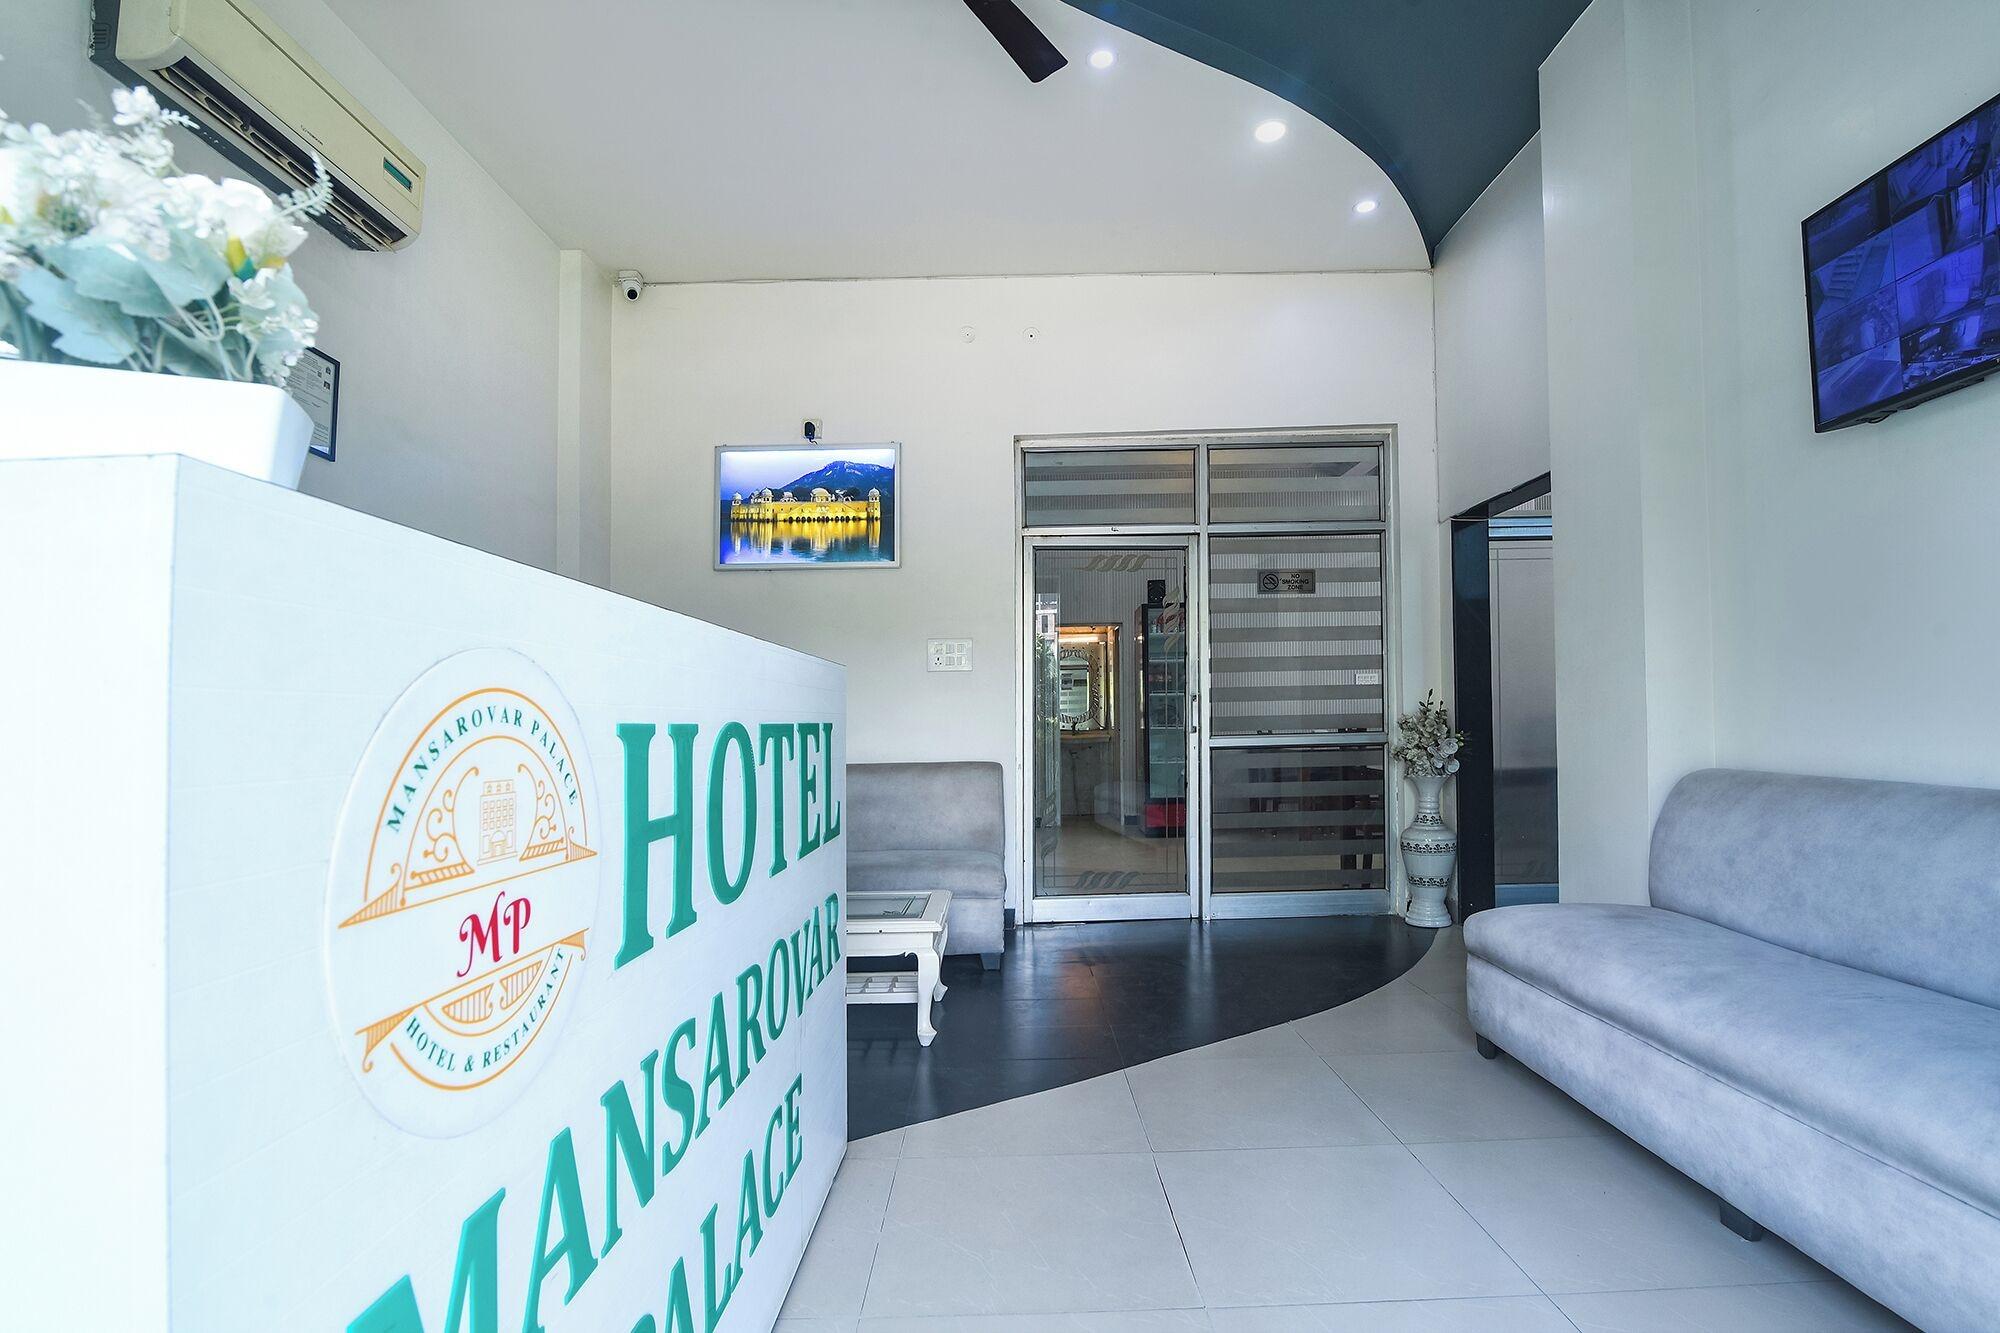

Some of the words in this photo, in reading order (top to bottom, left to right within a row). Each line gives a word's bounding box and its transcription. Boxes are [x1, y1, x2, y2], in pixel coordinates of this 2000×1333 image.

[386, 705, 523, 833] MANSAROVAR
[531, 720, 579, 806] PALACE
[613, 720, 842, 971] HOTEL
[456, 890, 532, 978] MP
[405, 1016, 456, 1072] HOTEL
[464, 1054, 474, 1073] &
[482, 947, 566, 1069] RESTAURANT
[629, 1072, 804, 1333] ALACE
